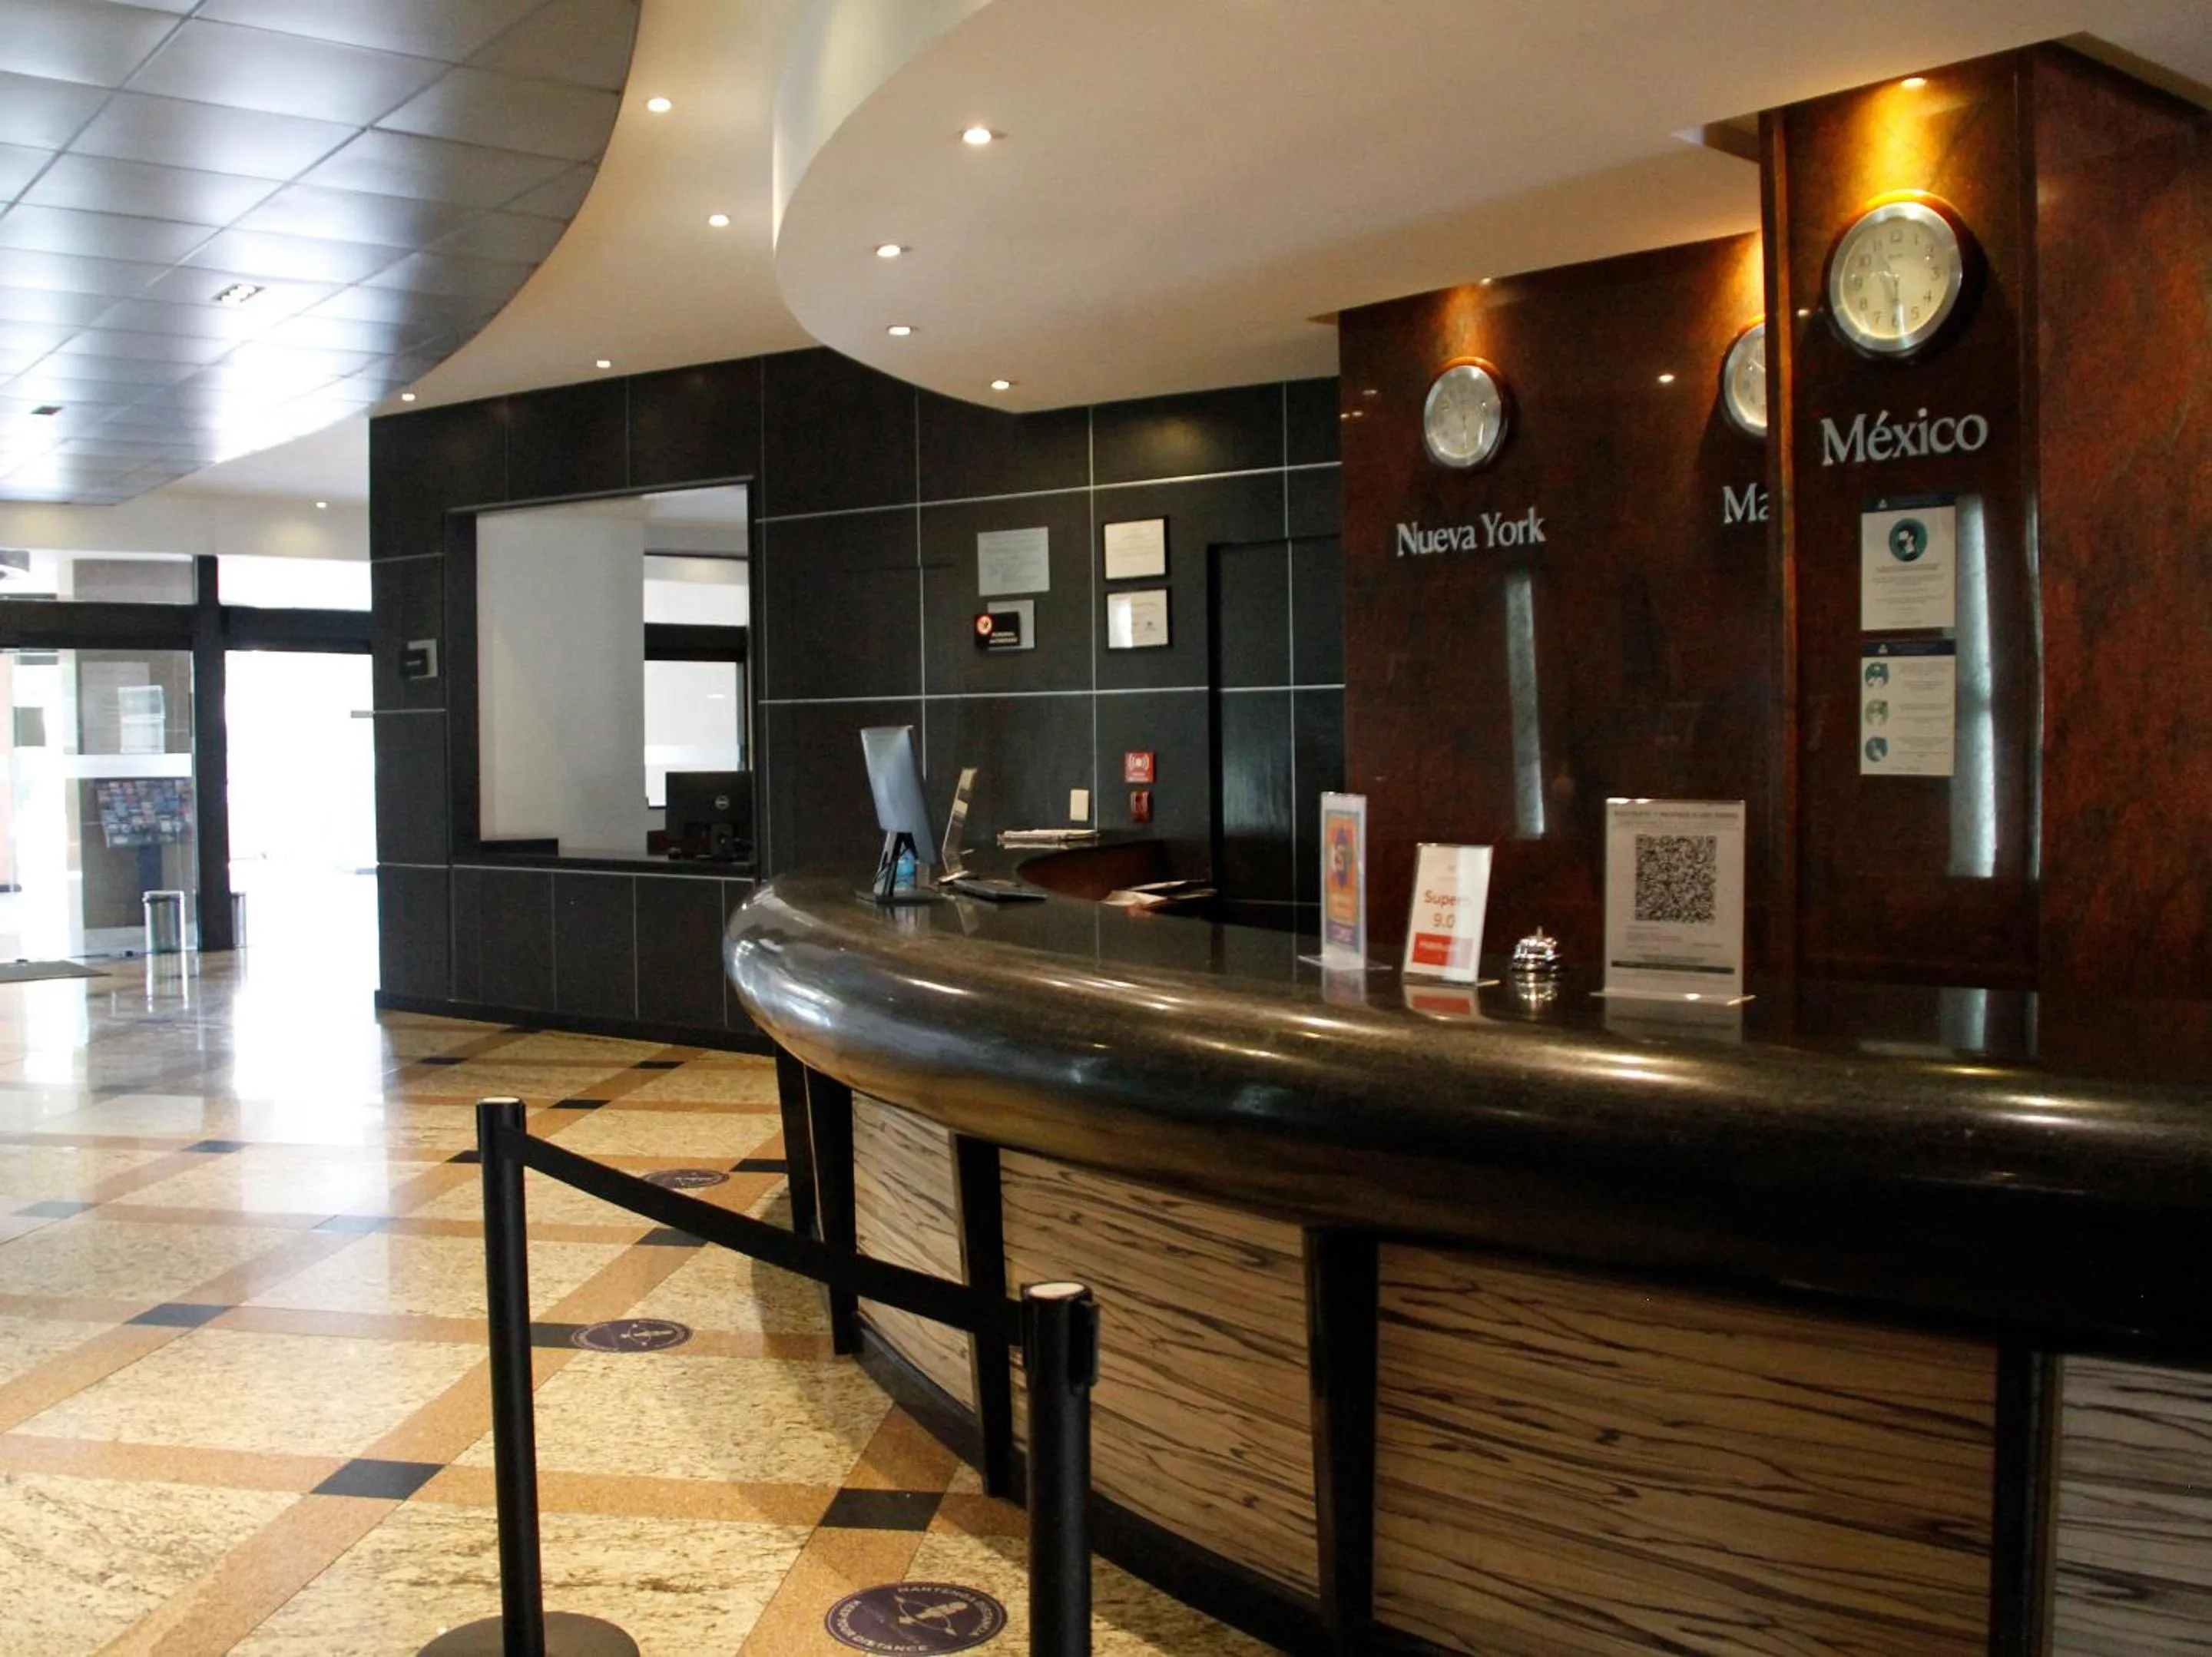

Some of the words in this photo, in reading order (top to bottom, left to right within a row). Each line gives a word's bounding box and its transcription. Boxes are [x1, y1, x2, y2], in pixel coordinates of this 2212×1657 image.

[1930, 266, 1940, 282] 3
[1922, 289, 1932, 304] 4
[1820, 408, 1988, 467] México
[1396, 521, 1478, 557] Nueva
[1480, 506, 1547, 548] York
